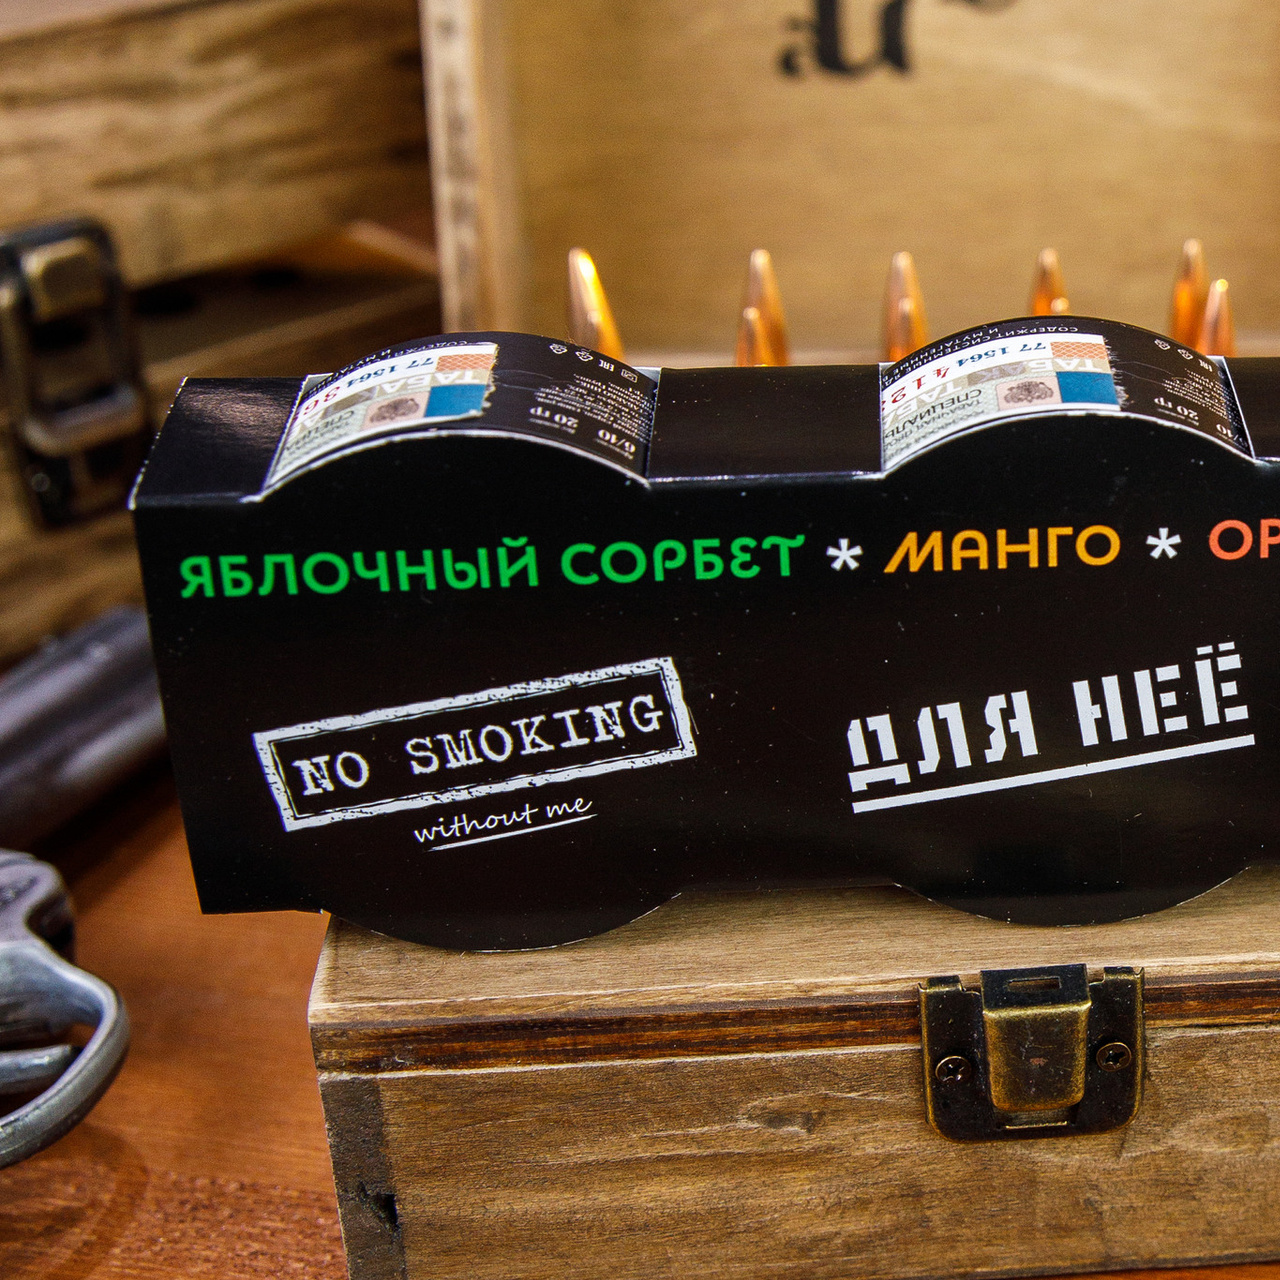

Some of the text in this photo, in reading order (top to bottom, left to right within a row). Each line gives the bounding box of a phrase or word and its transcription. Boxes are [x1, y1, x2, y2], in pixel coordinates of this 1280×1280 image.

[988, 327, 999, 335] И
[996, 326, 1079, 339] СОДЕРЖИТ
[956, 346, 1011, 368] 1564
[1019, 342, 1047, 353] 77
[406, 357, 434, 369] 77
[976, 359, 1103, 382] ТАБАК
[347, 364, 399, 388] 1564
[553, 413, 579, 429] 20
[883, 387, 983, 440] СПЕЦИАЛЬ
[1176, 405, 1200, 420] 20
[597, 428, 636, 454] 6/10
[181, 536, 540, 599] ЯБЛОЧНЫЙ
[560, 535, 806, 586] СОРБЕТ
[883, 524, 1121, 573] МАНГО
[847, 641, 1249, 792] ДЛЯ НЕЁ
[292, 694, 665, 796] NO SMOKING
[413, 794, 594, 844] without me
